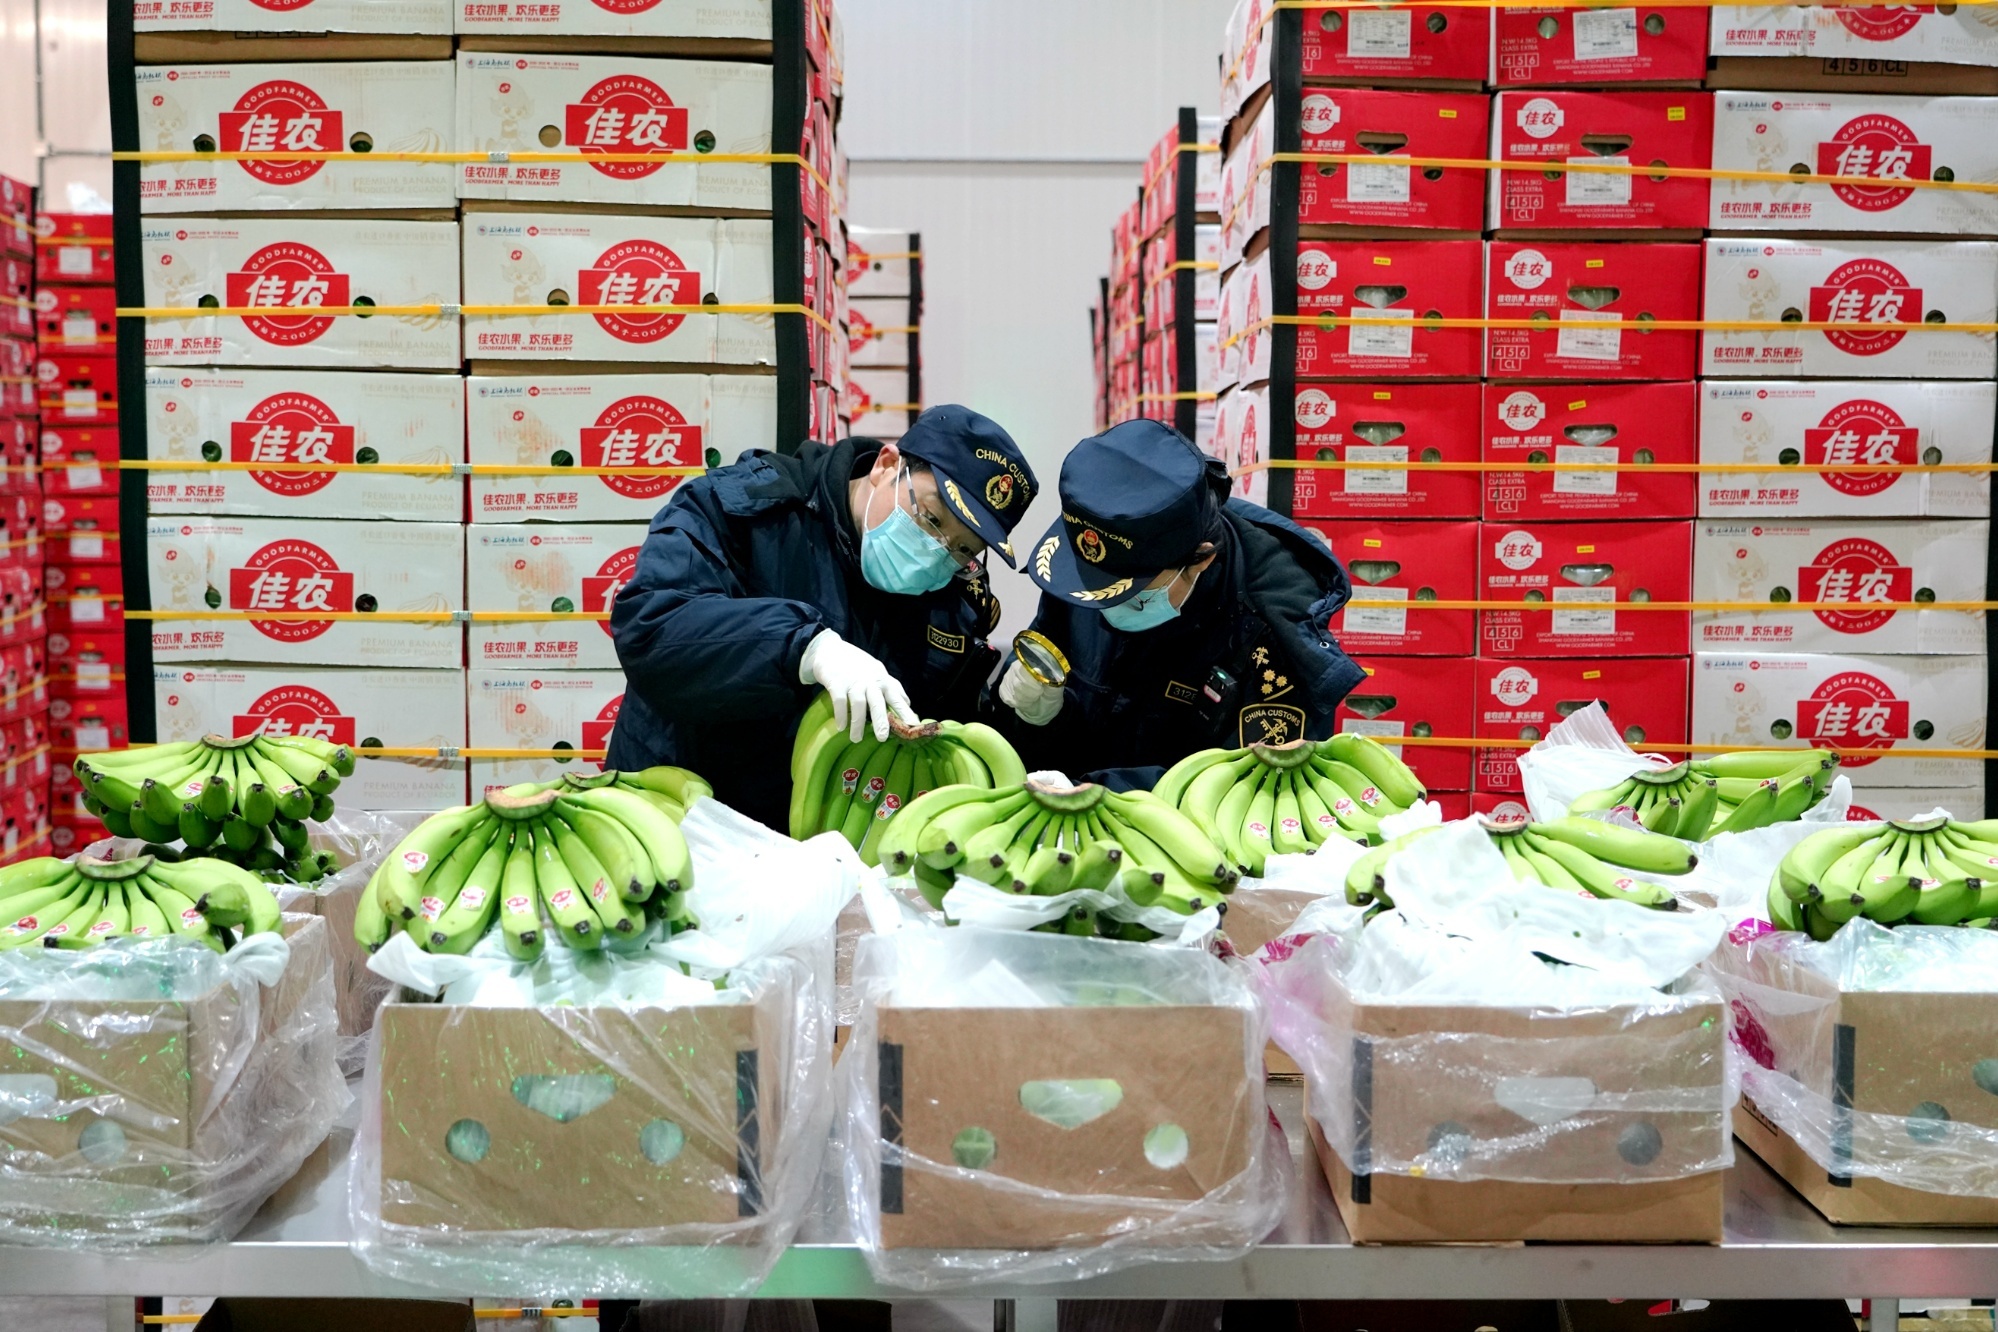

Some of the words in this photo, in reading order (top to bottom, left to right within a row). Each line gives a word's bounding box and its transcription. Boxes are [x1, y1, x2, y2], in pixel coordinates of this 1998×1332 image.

[1515, 68, 1526, 77] CL
[1830, 60, 1838, 70] 4
[1850, 60, 1858, 71] 5
[1868, 60, 1877, 71] 6
[1886, 60, 1904, 72] CL
[244, 87, 317, 109] GOODFARMER
[591, 81, 663, 102] GOODFARMER
[1302, 107, 1332, 121] 佳农
[1525, 111, 1556, 125] 佳农
[239, 113, 325, 152] 佳农
[585, 108, 668, 147] 佳农
[1842, 120, 1909, 141] GOODFARMER
[1836, 145, 1912, 179] 佳农
[1519, 210, 1529, 218] CL
[252, 249, 325, 270] GOODFARMER
[603, 246, 677, 267] GOODFARMER
[1297, 262, 1328, 277] 佳农
[1513, 262, 1544, 276] 佳农
[1833, 265, 1900, 285] GOODFARMER
[246, 275, 329, 307] 佳农
[597, 272, 680, 305] 佳农
[1828, 289, 1904, 323] 佳农
[256, 399, 329, 420] GOODFARMER
[605, 402, 676, 424] GOODFARMER
[1297, 401, 1328, 416] 佳农
[1506, 404, 1537, 418] 佳农
[1828, 406, 1895, 426] GOODFARMER
[251, 425, 334, 464] 佳农
[600, 429, 683, 466] 佳农
[1823, 430, 1900, 465] 佳农
[976, 448, 1008, 468] CHINA
[1501, 502, 1512, 510] CL
[1084, 520, 1133, 549] CUSTOMS
[256, 546, 329, 566] GOODFARMER
[1503, 543, 1534, 558] 佳农
[1822, 544, 1888, 565] GOODFARMER
[249, 572, 333, 611] 佳农
[1816, 568, 1893, 603] 佳农
[1499, 679, 1530, 693] 佳农
[1820, 678, 1885, 698] GOODFARMER
[258, 691, 330, 713] GOODFARMER
[1244, 710, 1266, 723] CHINA
[1268, 709, 1300, 726] CUSTOMS
[1814, 702, 1891, 737] 佳农
